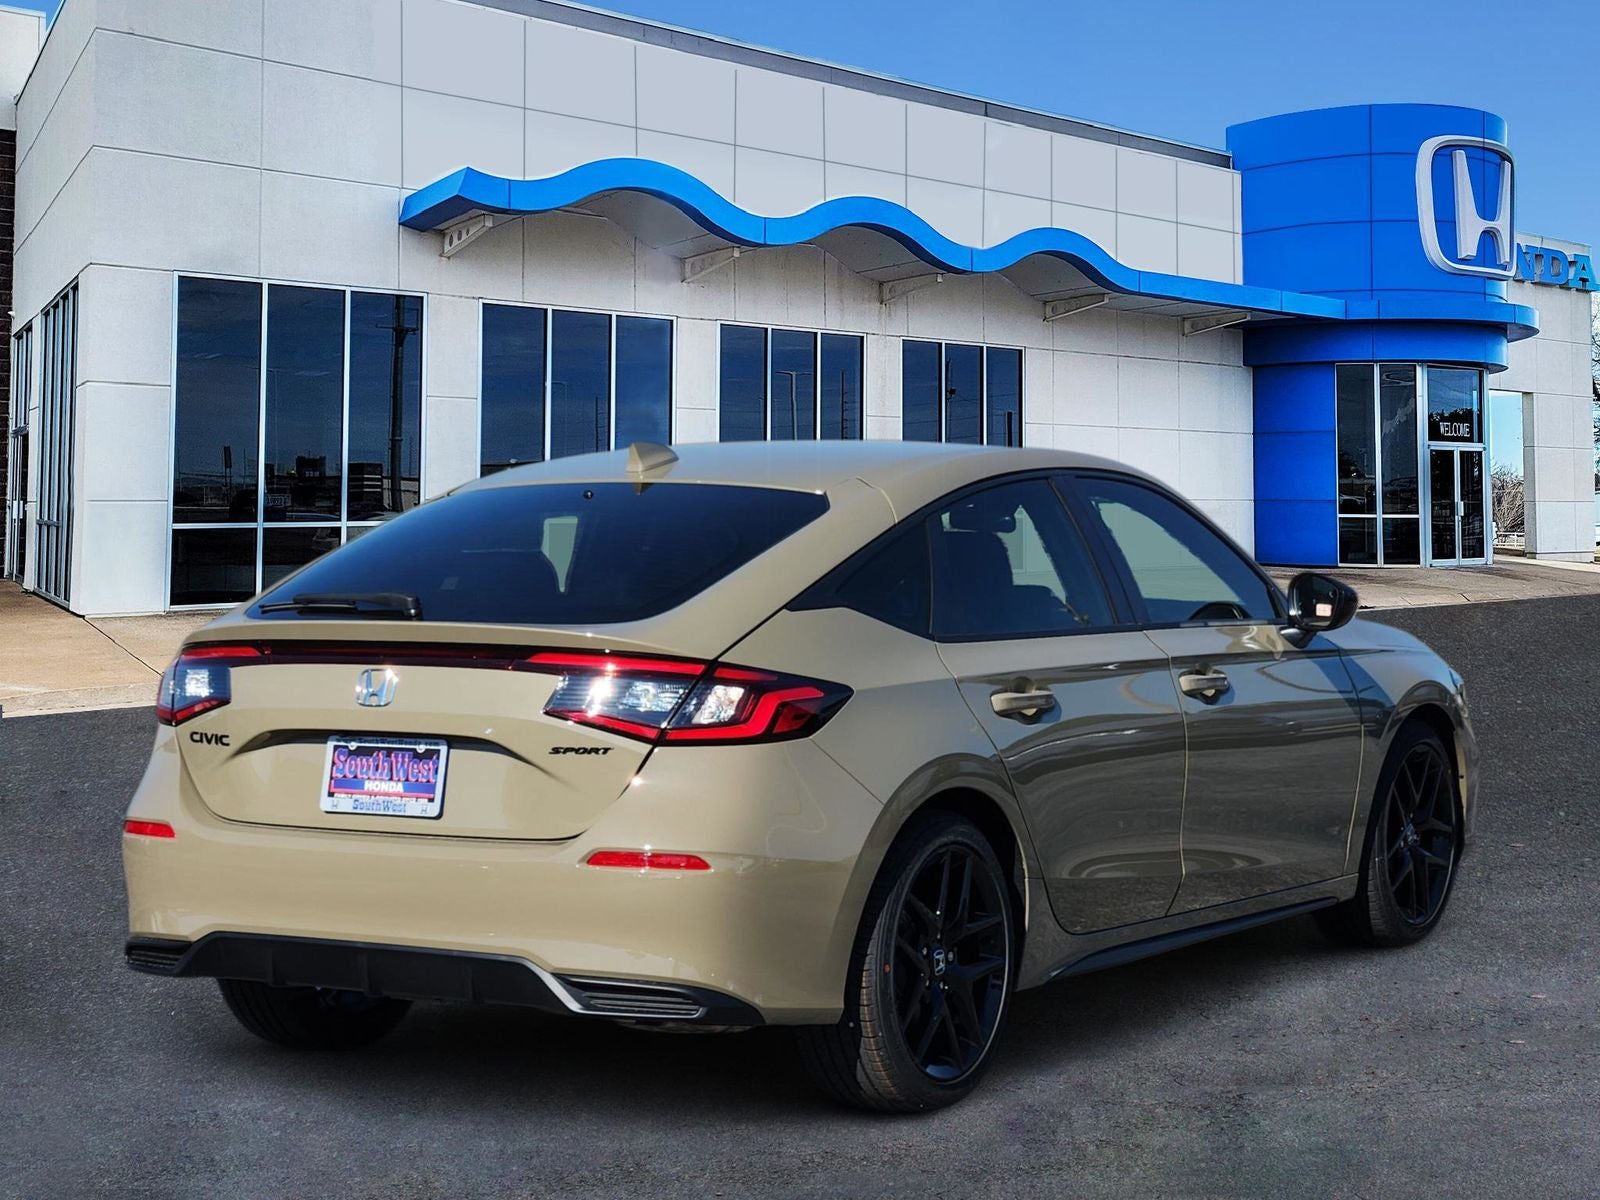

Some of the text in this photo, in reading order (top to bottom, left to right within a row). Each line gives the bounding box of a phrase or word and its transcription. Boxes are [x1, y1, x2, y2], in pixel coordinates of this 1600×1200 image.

[1514, 243, 1600, 291] NDA
[1439, 422, 1471, 437] WELCOME
[190, 731, 230, 746] CIVIC
[548, 746, 614, 755] SPORT
[332, 748, 438, 782] SouthWest
[364, 781, 404, 792] HONDA
